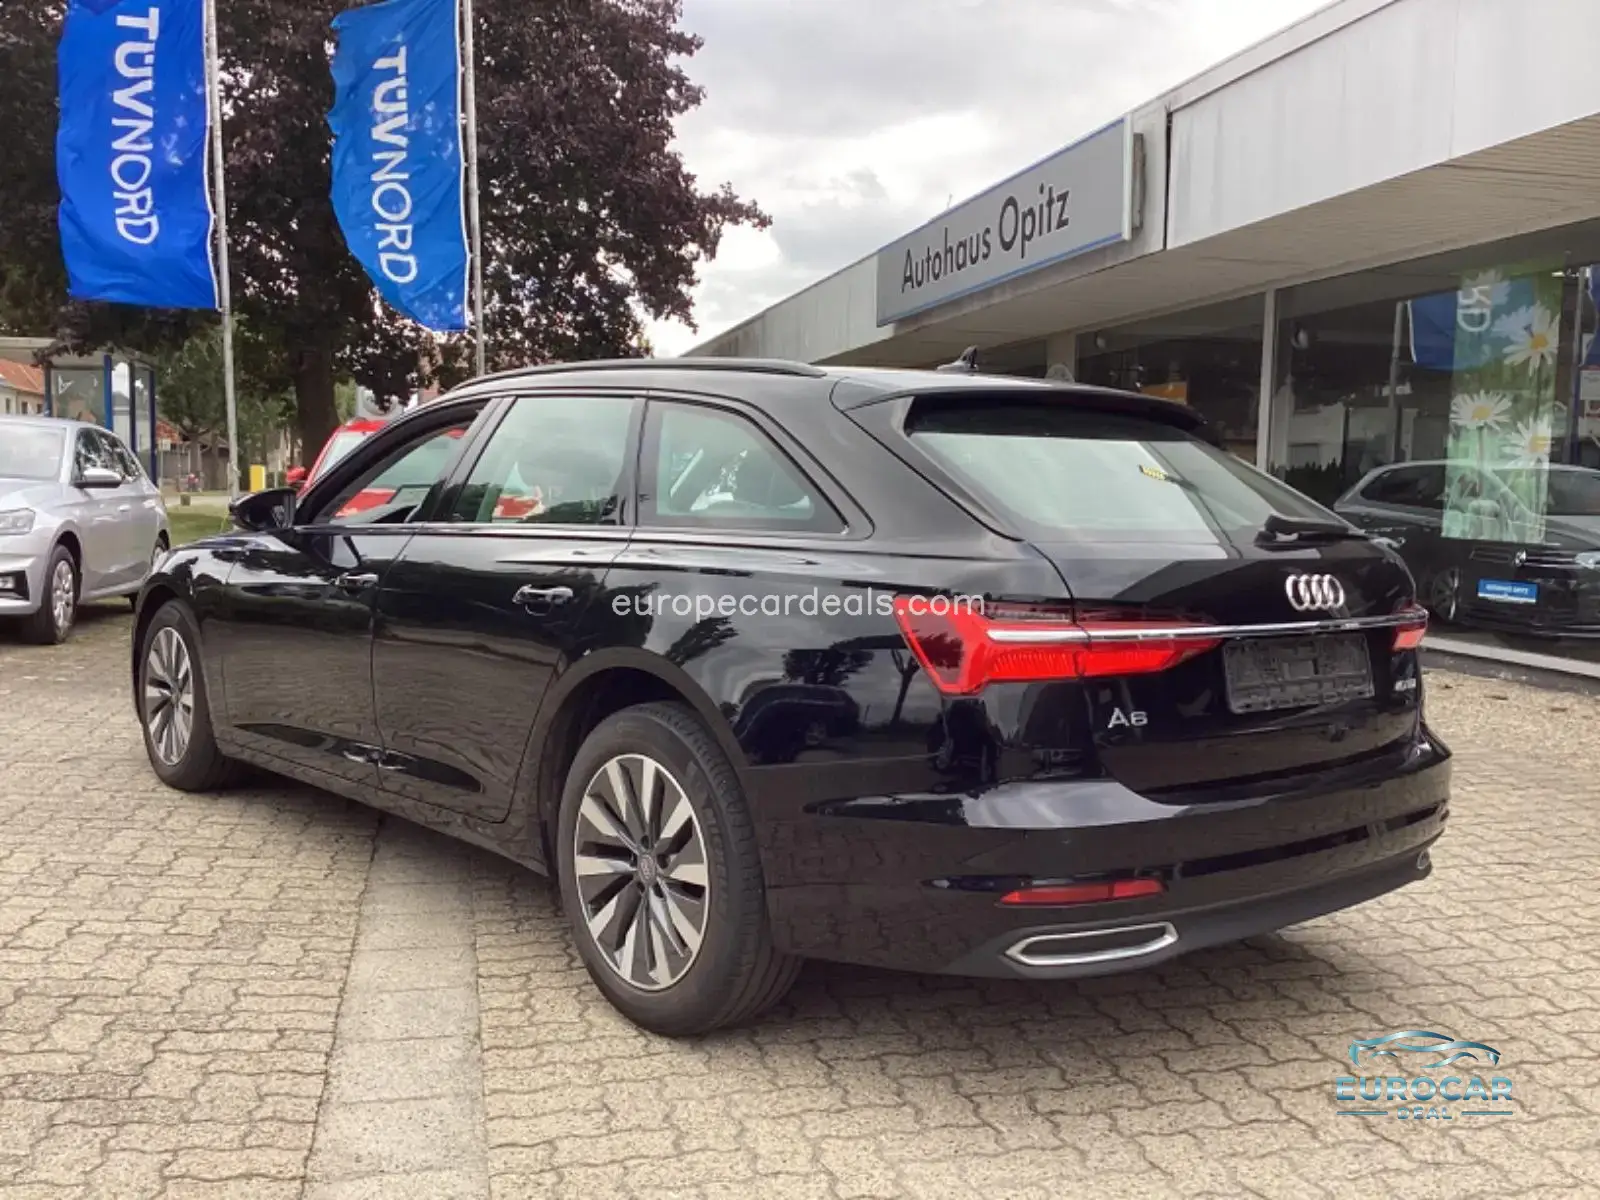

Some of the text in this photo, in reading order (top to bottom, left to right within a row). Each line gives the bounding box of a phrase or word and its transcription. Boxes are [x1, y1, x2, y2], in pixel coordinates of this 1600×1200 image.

[902, 182, 1070, 294] Autohaus Opitz
[1107, 707, 1148, 729] A6
